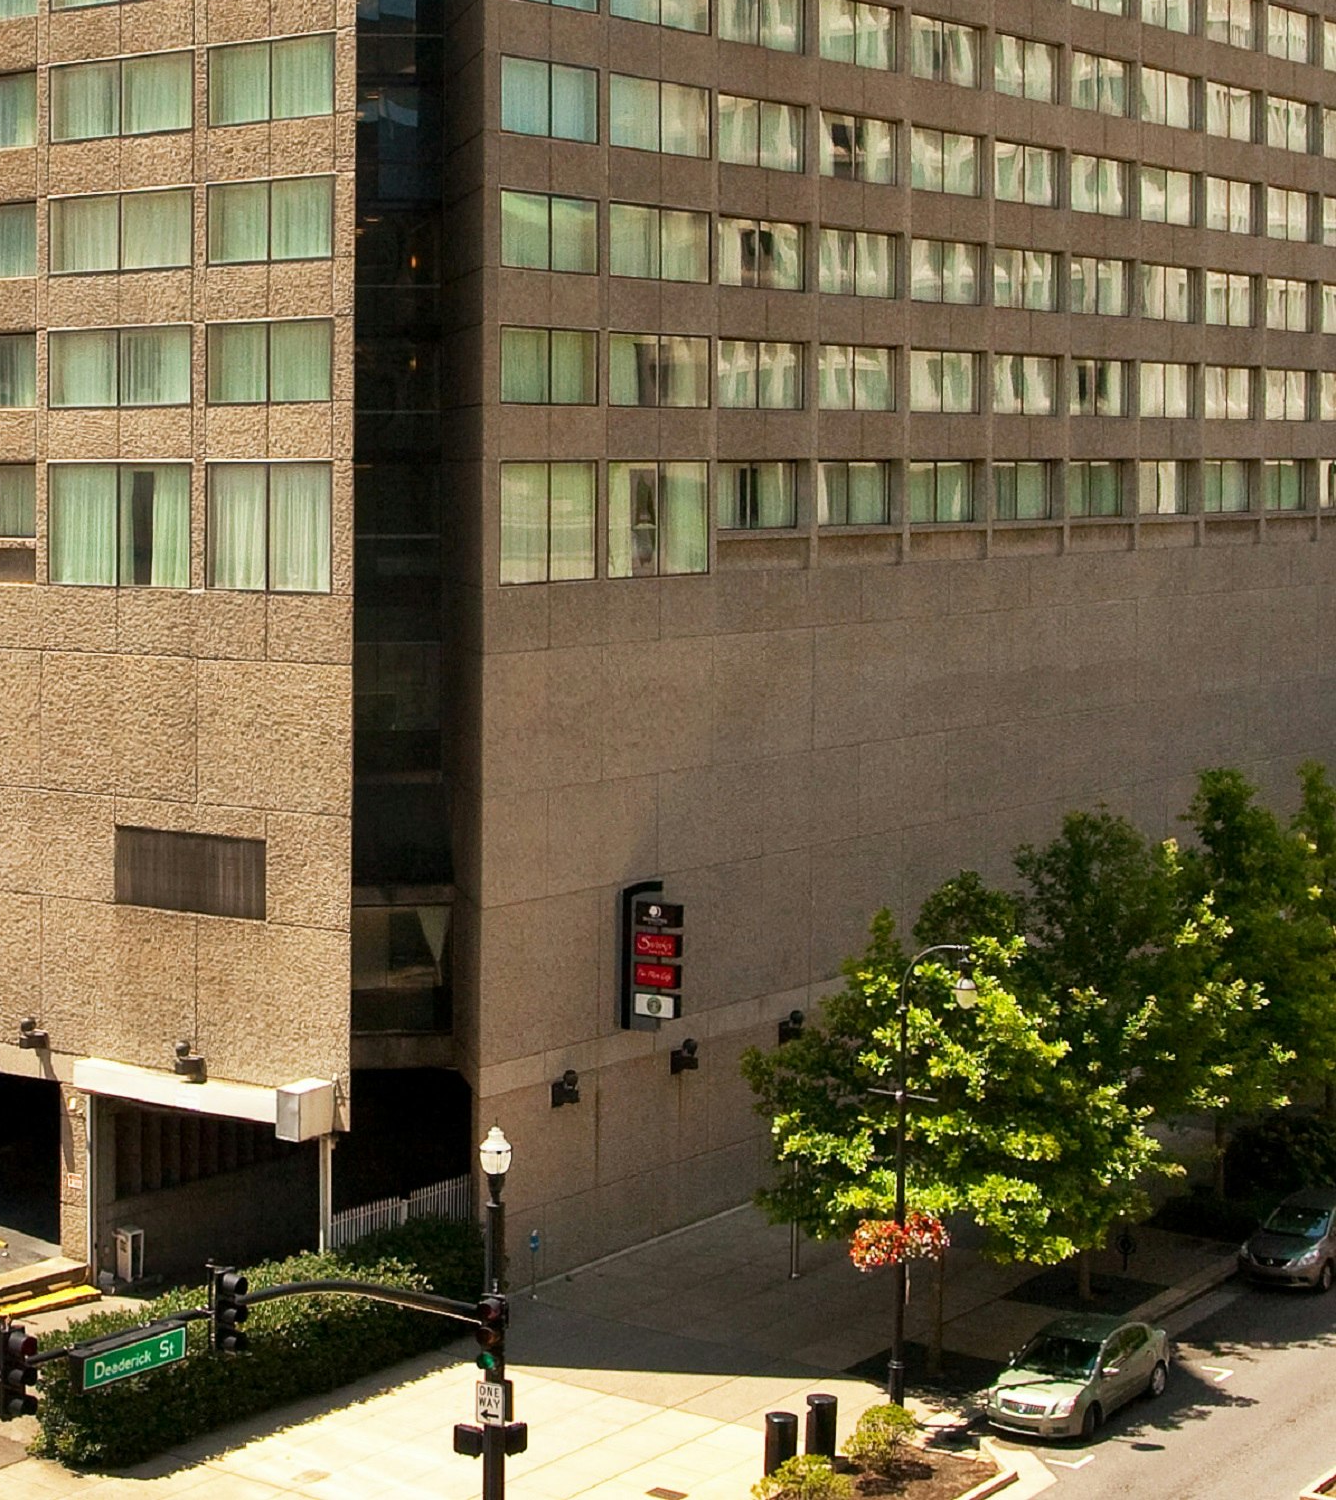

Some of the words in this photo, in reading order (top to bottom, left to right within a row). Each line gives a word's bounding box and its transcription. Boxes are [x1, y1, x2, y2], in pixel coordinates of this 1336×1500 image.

[94, 1350, 152, 1380] Deaderick
[159, 1339, 175, 1358] St
[479, 1385, 500, 1398] ONE
[479, 1397, 500, 1409] WAY
